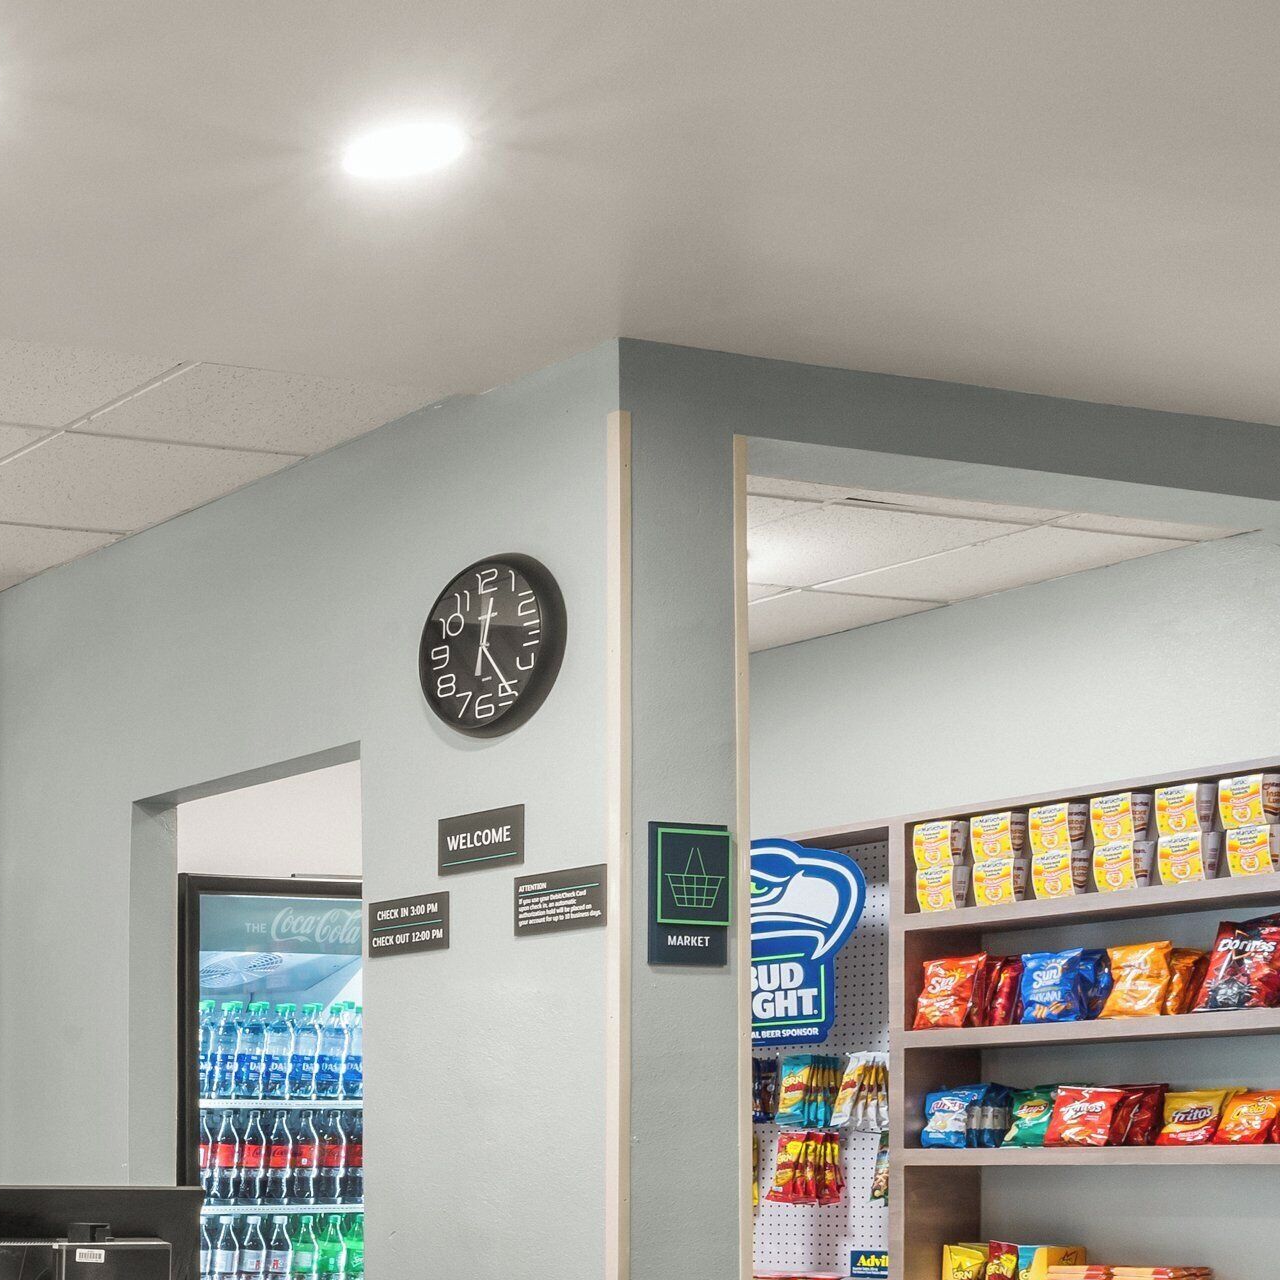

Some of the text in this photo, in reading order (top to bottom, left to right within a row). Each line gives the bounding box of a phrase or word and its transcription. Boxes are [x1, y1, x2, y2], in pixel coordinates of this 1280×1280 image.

[476, 568, 498, 595] 12
[508, 570, 515, 591] 1
[454, 590, 470, 613] 11
[518, 590, 536, 616] 2
[439, 613, 465, 639] 10
[523, 619, 540, 647] 3
[431, 645, 449, 670] 9
[437, 673, 456, 698] 8
[498, 680, 518, 706] 5
[455, 691, 472, 718] 7
[475, 694, 495, 719] 6
[447, 825, 511, 851] WELCOME
[519, 882, 547, 892] ATTENTION
[377, 902, 438, 921] CHECK IN 3:00 PM
[244, 907, 362, 945] THE Coca-Cola
[372, 928, 443, 948] CHECK OUT 12:00 PM
[667, 935, 710, 947] MARKET
[752, 988, 819, 1019] GHT
[761, 1027, 781, 1039] BEER
[781, 1027, 819, 1038] SPONSOR
[1171, 1105, 1213, 1123] Fritos
